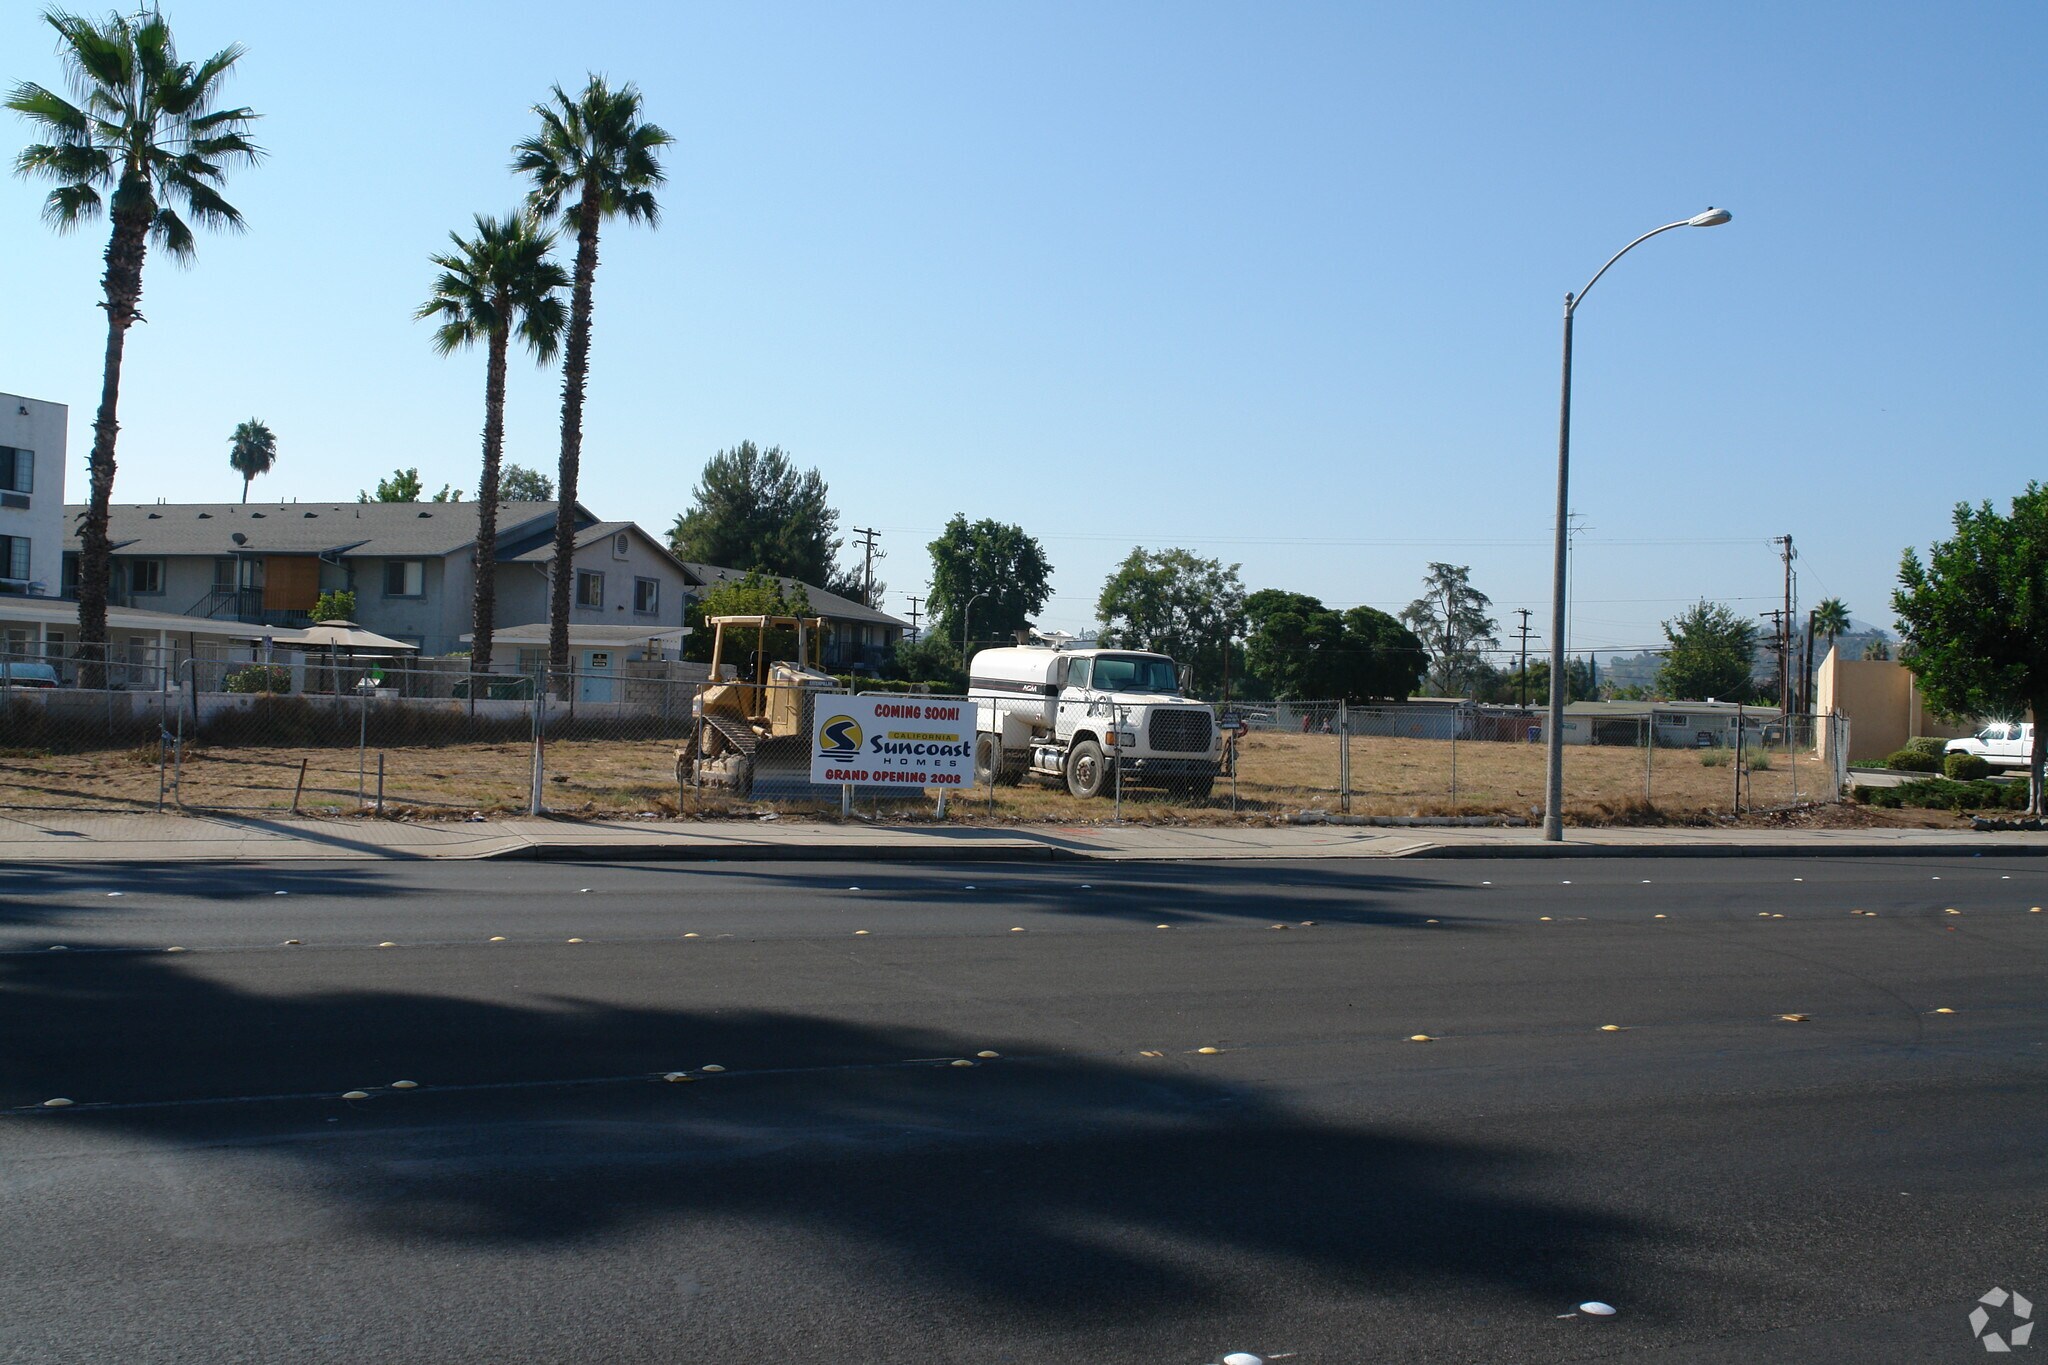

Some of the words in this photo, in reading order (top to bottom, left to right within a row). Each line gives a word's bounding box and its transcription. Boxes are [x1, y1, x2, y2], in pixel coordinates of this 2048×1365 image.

[874, 704, 921, 719] COMING
[924, 707, 960, 721] SOON!
[894, 733, 952, 741] CALIFORNIA
[870, 734, 971, 757] Suncoast
[884, 758, 957, 767] HOMES
[825, 769, 869, 781] GRAND
[872, 771, 927, 783] OPENING
[930, 774, 961, 784] 2008
